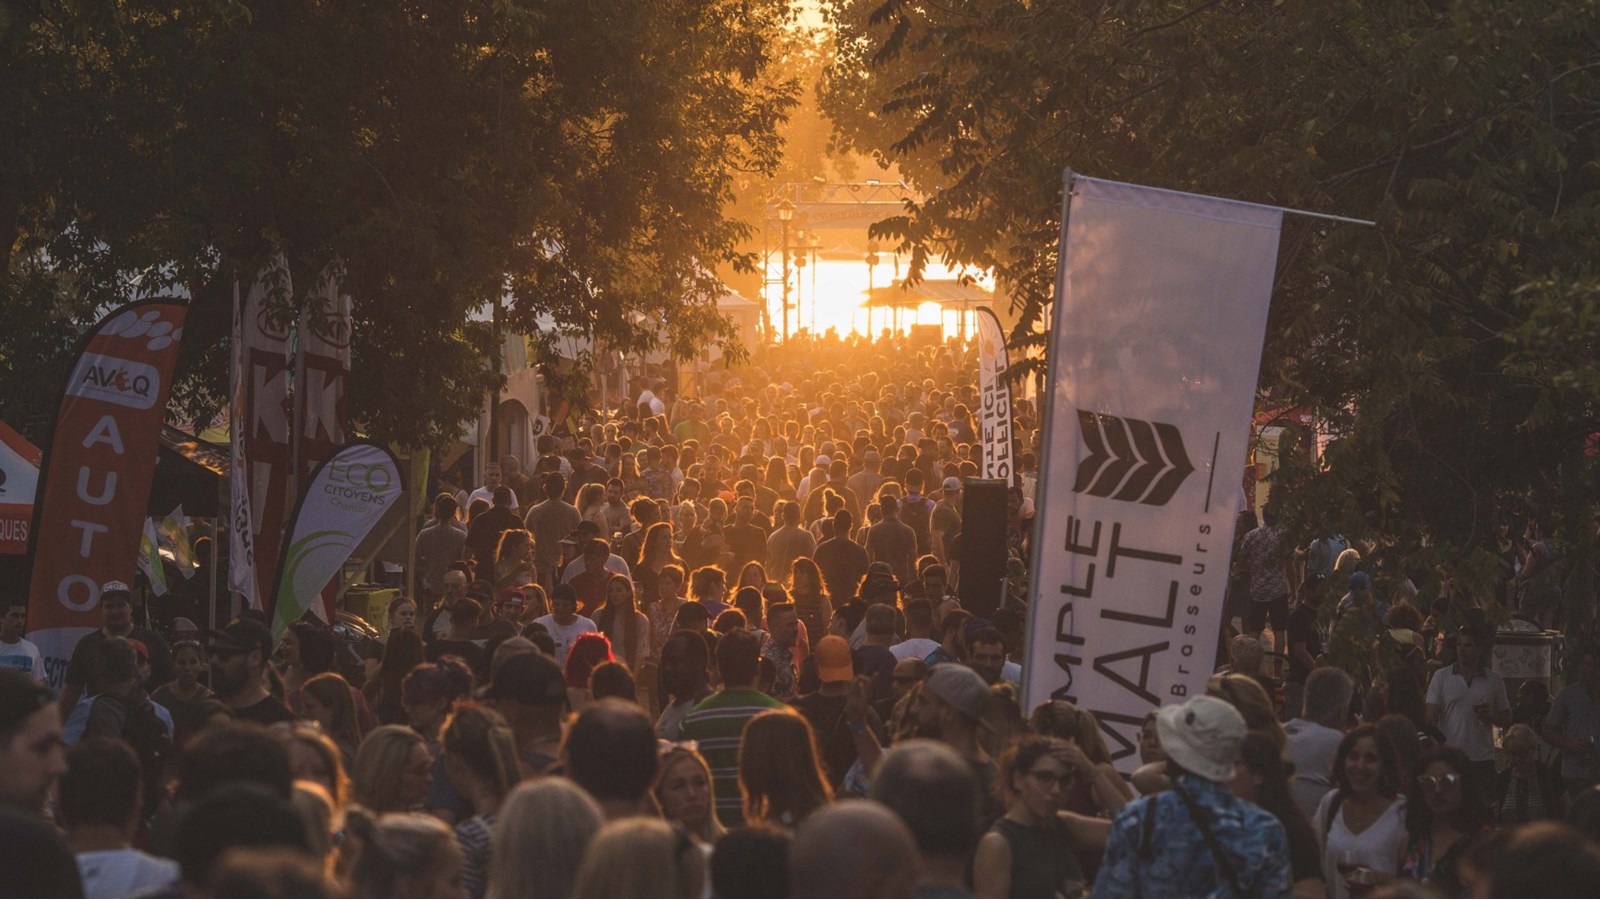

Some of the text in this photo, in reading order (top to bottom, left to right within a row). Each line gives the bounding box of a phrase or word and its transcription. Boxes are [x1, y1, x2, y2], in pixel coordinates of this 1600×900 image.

[57, 415, 125, 612] AUTO
[324, 484, 385, 505] CITOYENS
[328, 456, 391, 493] ECO
[1087, 522, 1183, 781] MALT
[1171, 523, 1211, 696] Brasseurs
